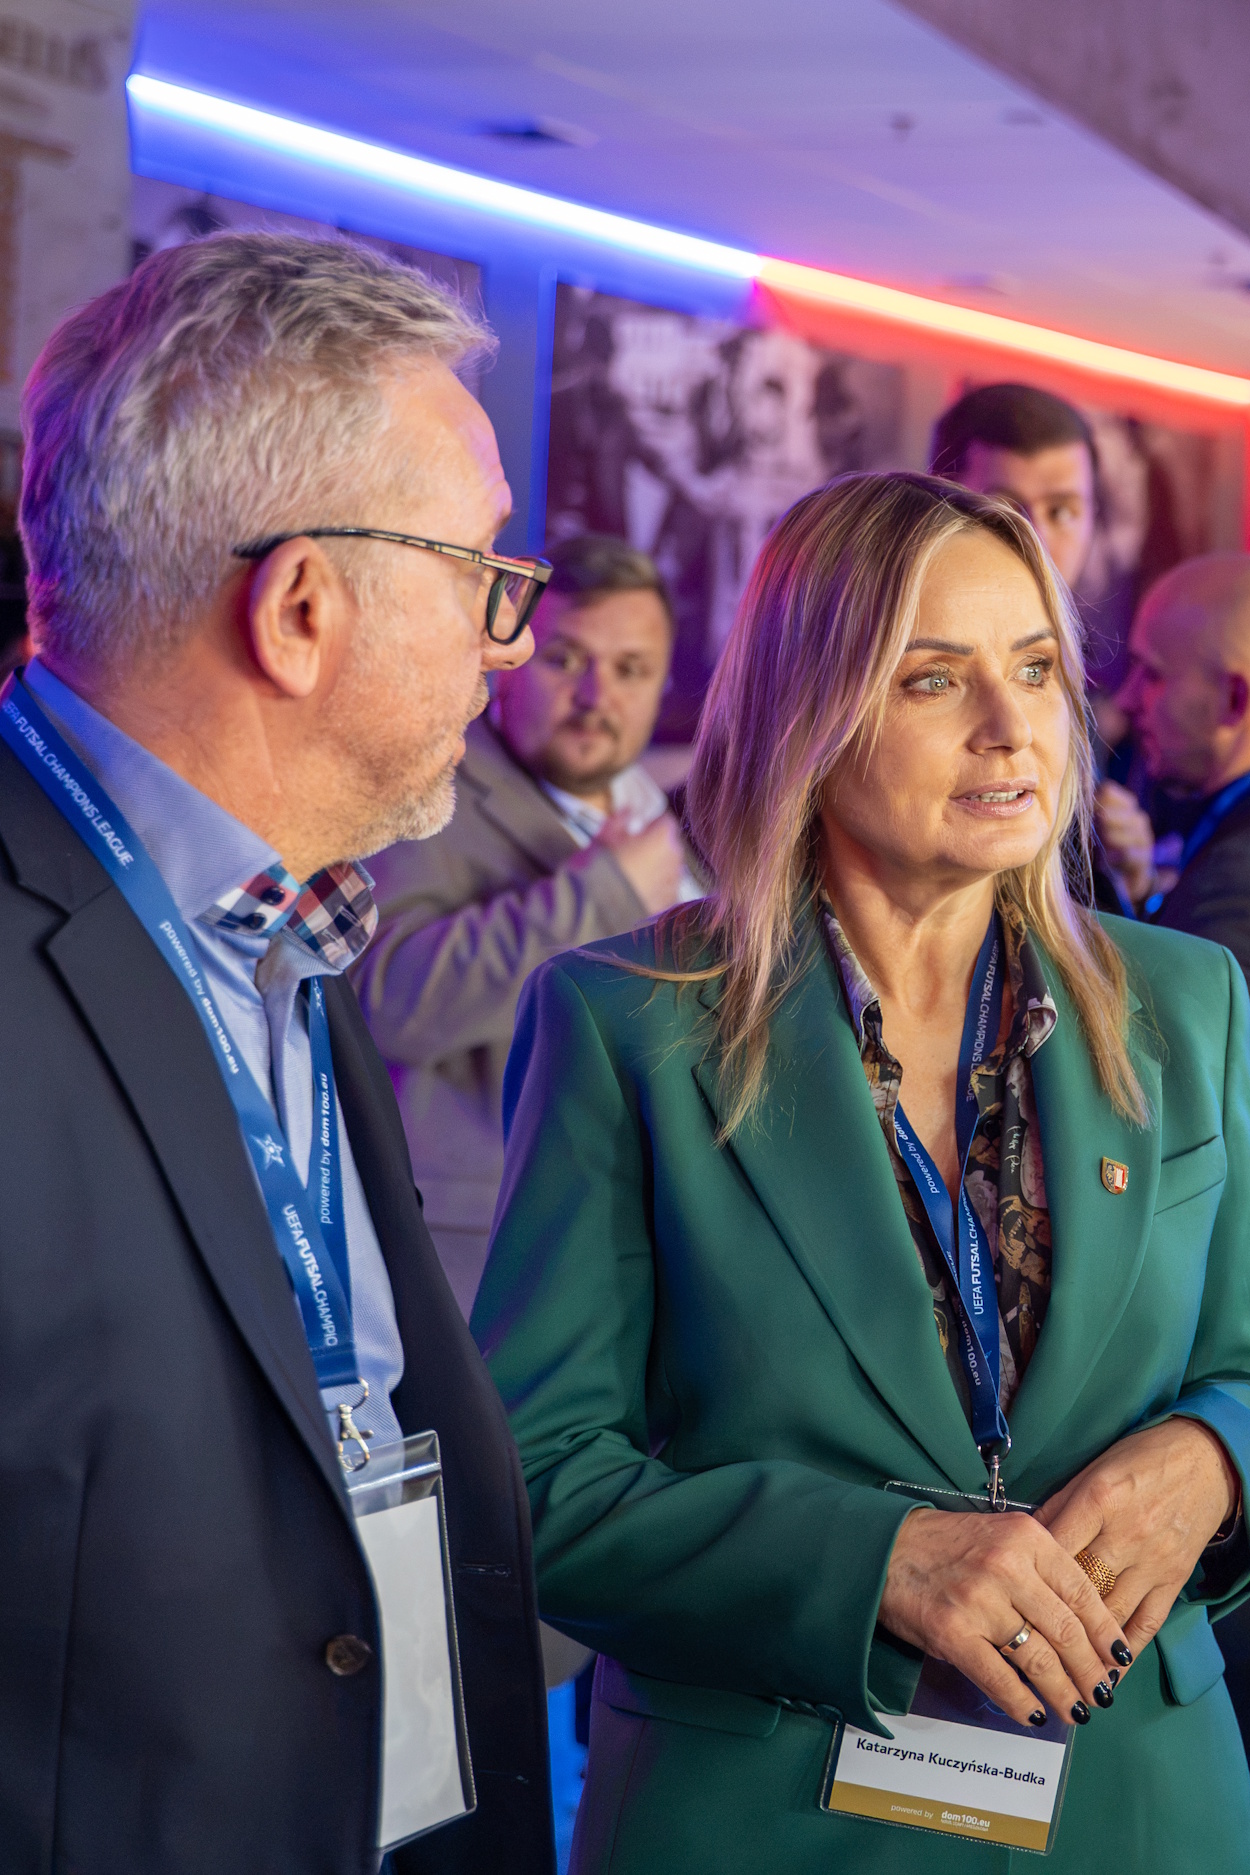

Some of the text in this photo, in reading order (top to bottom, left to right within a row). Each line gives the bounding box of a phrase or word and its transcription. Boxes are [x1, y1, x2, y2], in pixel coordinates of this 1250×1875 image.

[15, 716, 48, 757] FUTSAL
[43, 753, 100, 819] CHAMPIONS
[91, 815, 135, 868] LEAGUE
[159, 921, 239, 1075] powered by dom100.eu
[981, 964, 996, 1002] FUTSAL
[971, 1003, 990, 1062] CHAMPIONS
[319, 1072, 334, 1225] powered by dom100.eu
[906, 1140, 917, 1152] by
[911, 1153, 941, 1194] powered
[283, 1204, 304, 1246] UEFA
[296, 1238, 324, 1291] FUTSAL
[970, 1240, 982, 1285] FUTSAL
[973, 1285, 984, 1315] UEFA
[856, 1737, 1046, 1786] Katarzyna Kuczyńska-Budka
[890, 1804, 923, 1816] powered
[924, 1810, 934, 1820] by
[941, 1810, 990, 1828] dom100.eu
